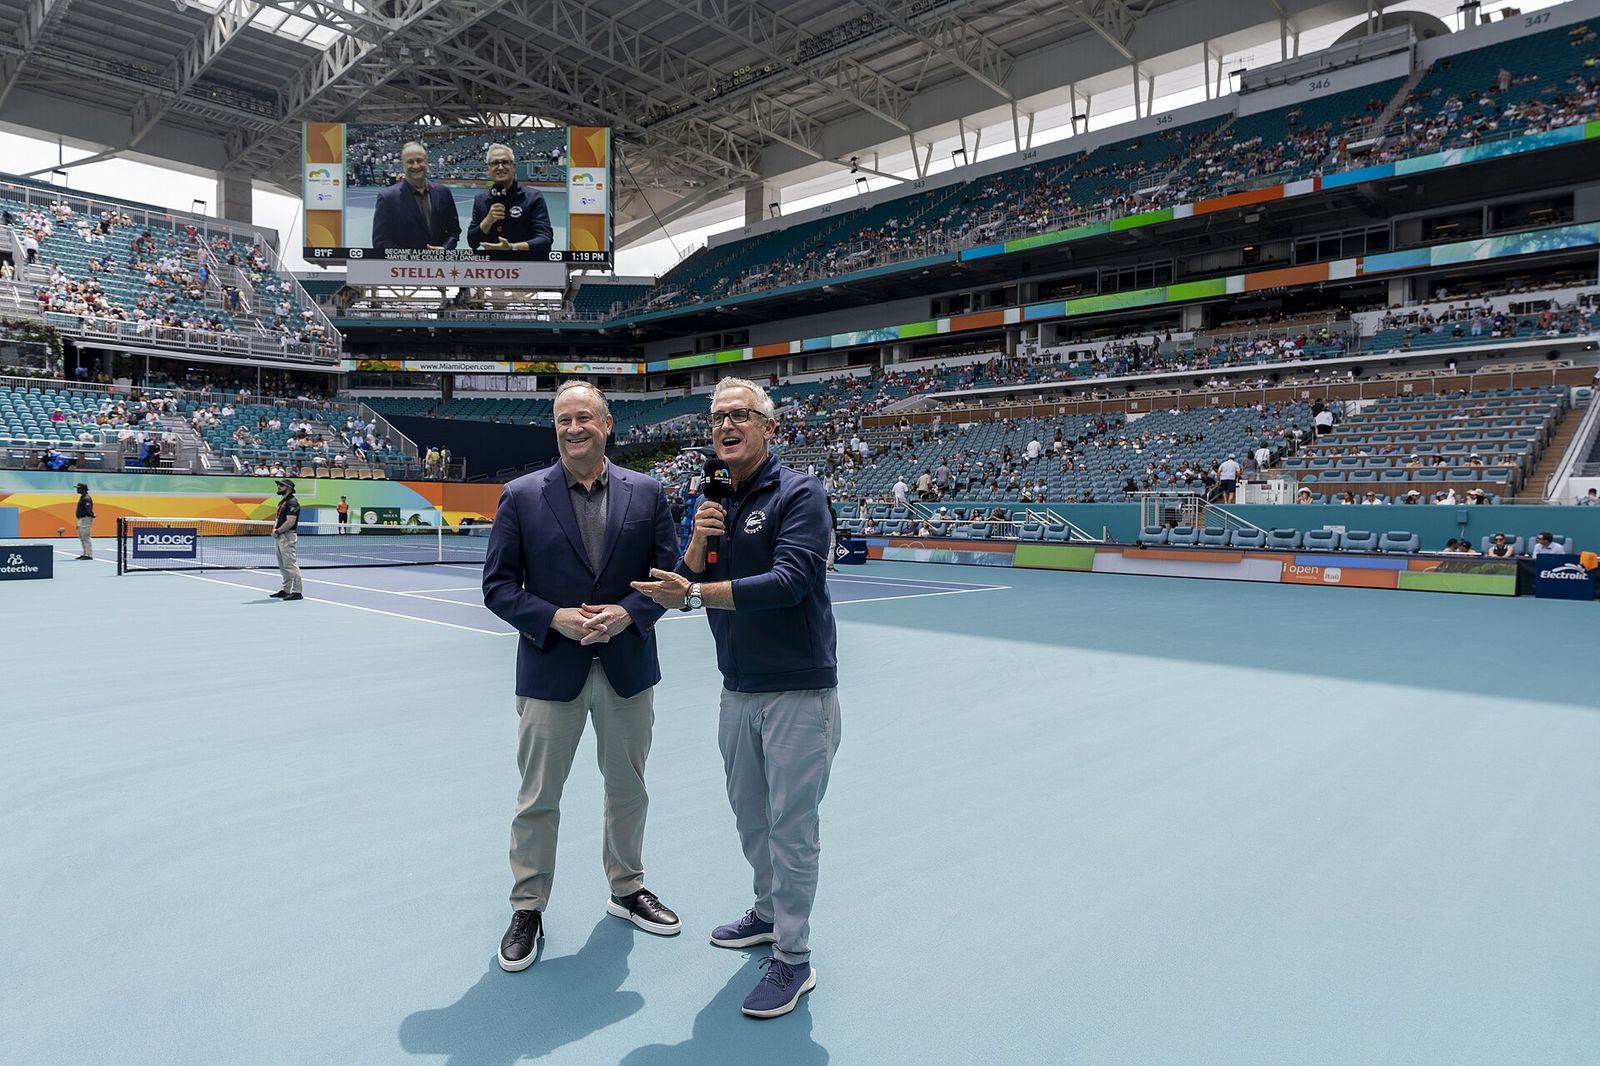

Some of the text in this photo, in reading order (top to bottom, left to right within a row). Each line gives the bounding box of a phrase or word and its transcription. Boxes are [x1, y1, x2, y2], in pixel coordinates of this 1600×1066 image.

[1524, 12, 1551, 28] 347
[1308, 78, 1330, 91] 346
[1156, 114, 1172, 126] 345
[1022, 150, 1036, 160] 344
[913, 180, 925, 190] 343
[314, 249, 333, 257] 81°F
[390, 267, 520, 279] STELLA ARTOIS
[420, 363, 495, 371] www.MiamiOpen.com
[137, 534, 193, 545] HOLOGIC
[1289, 565, 1319, 575] open
[1540, 570, 1589, 580] Electrolit
